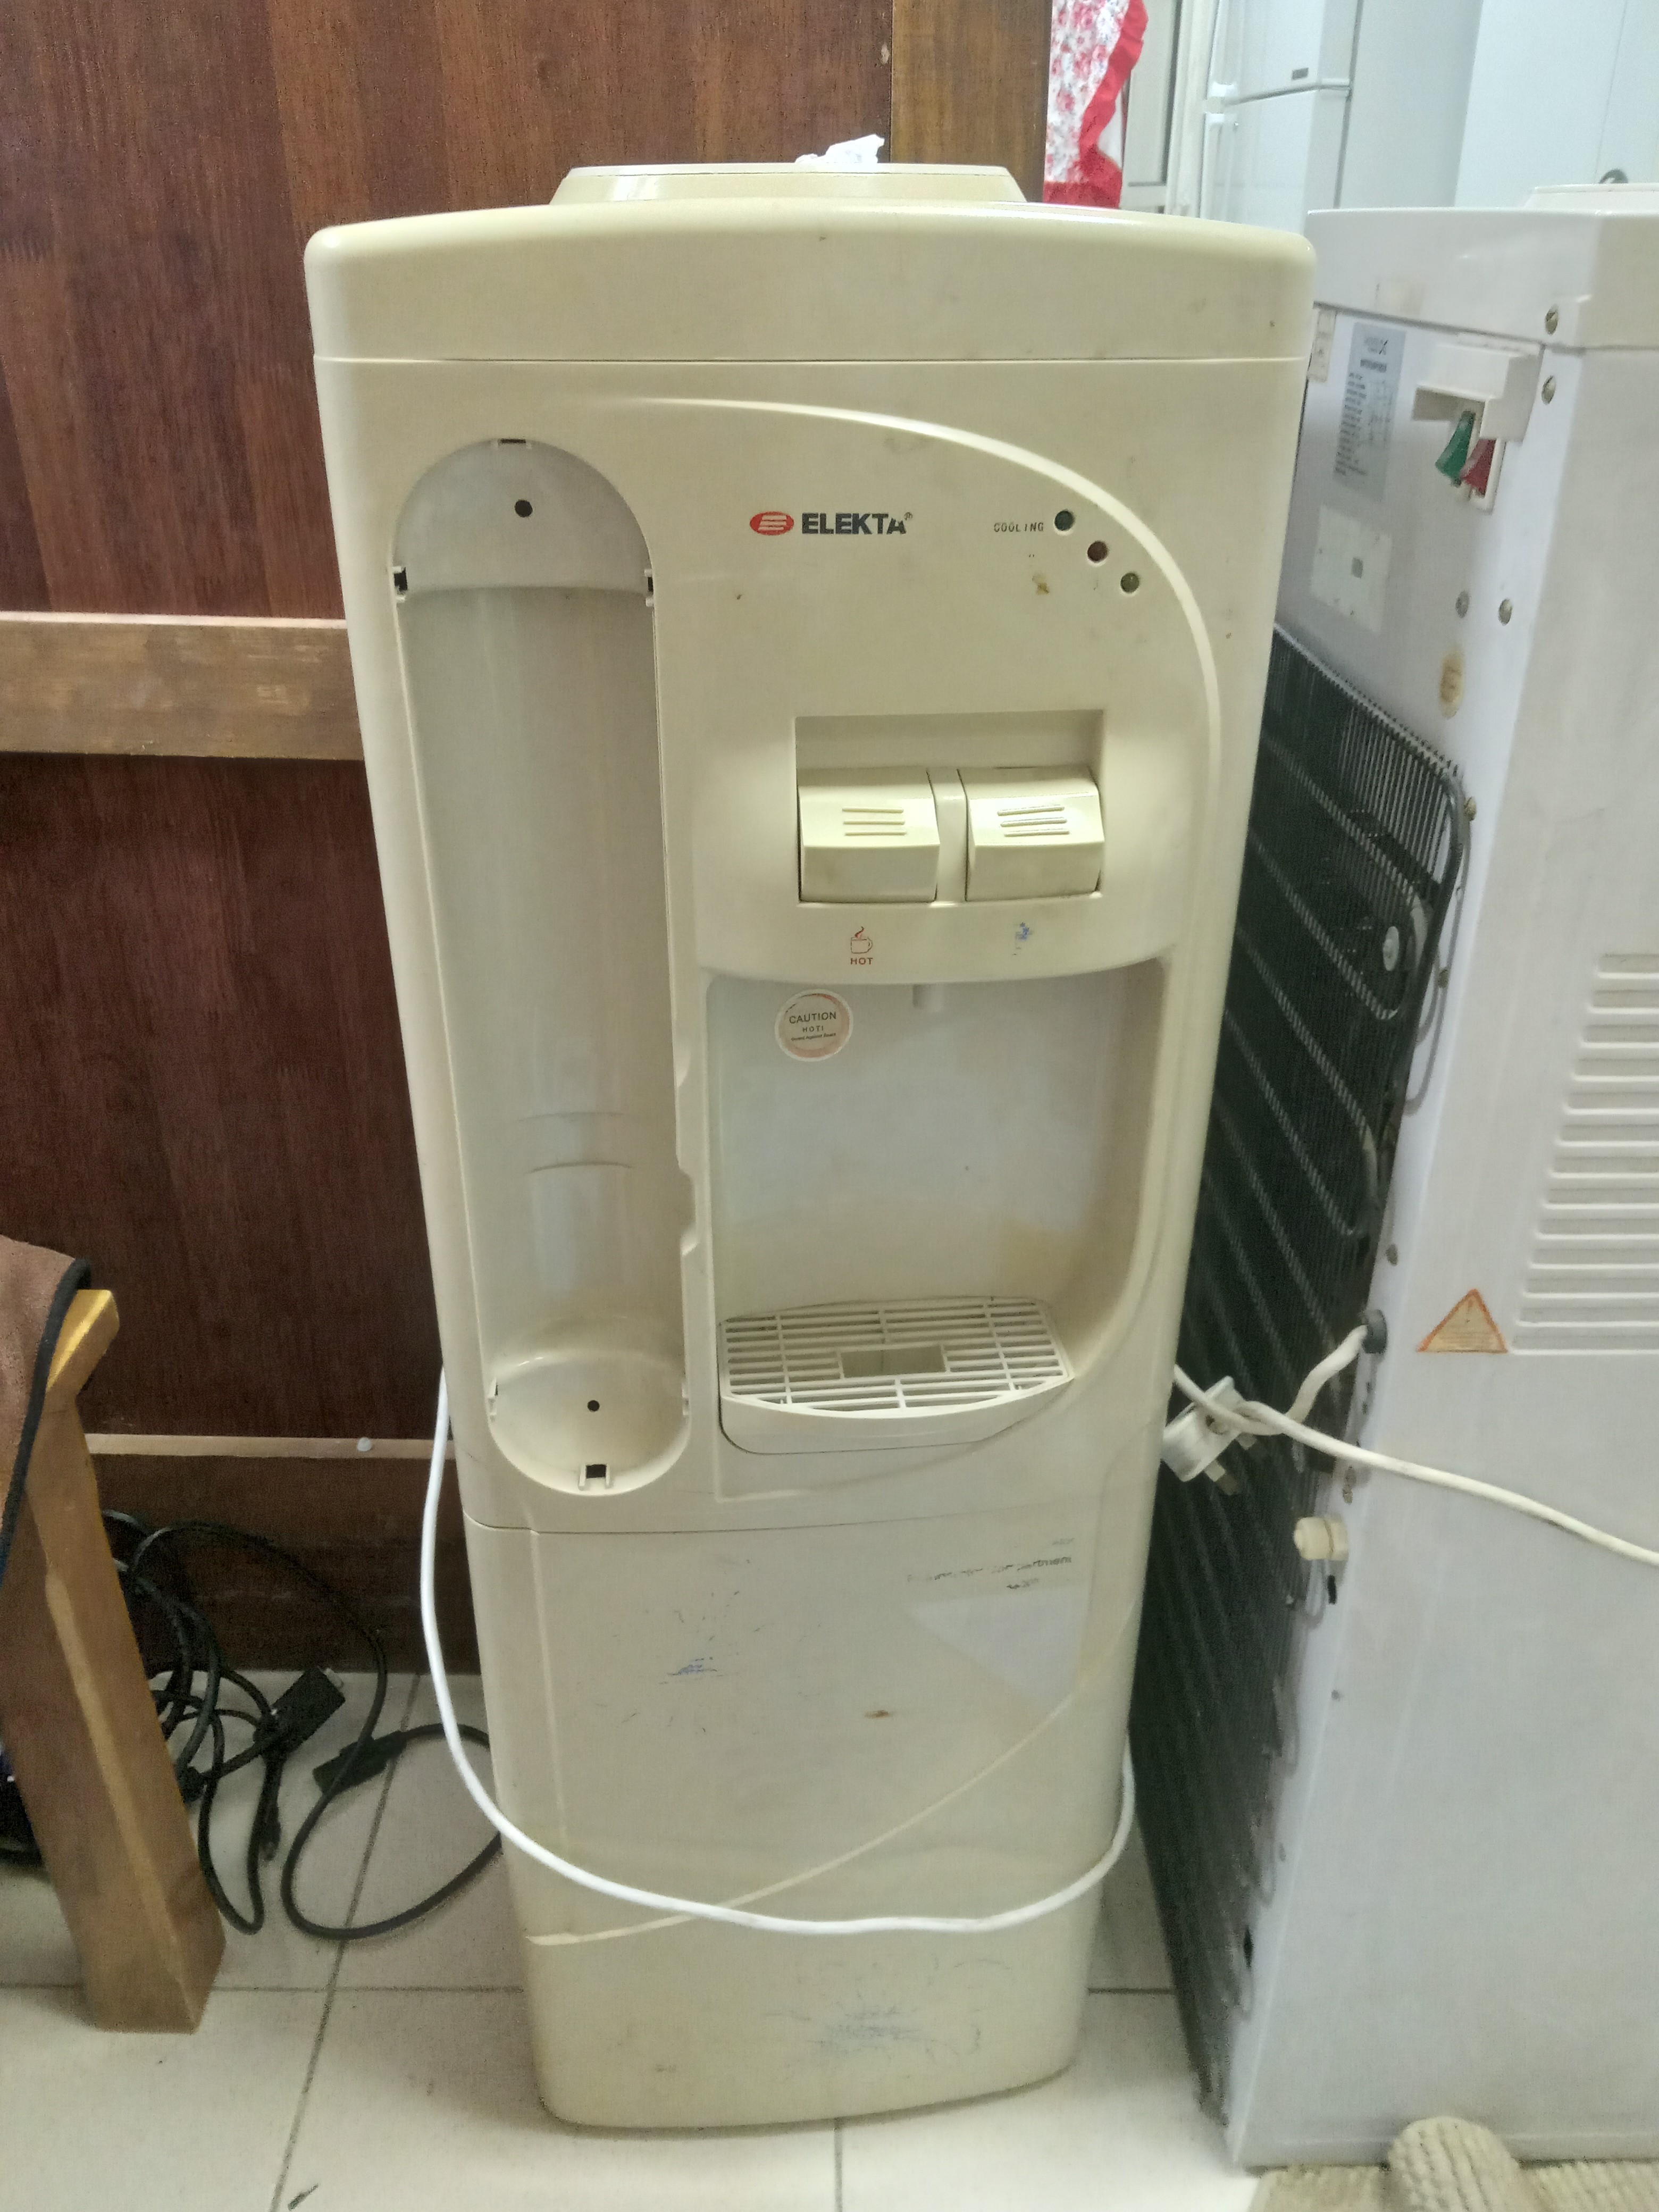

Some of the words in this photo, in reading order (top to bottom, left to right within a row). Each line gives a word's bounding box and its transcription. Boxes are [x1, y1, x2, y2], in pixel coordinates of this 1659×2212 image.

[802, 513, 906, 534] ELEKTA
[994, 522, 1044, 532] COOLING
[789, 1011, 836, 1024] CAUTION
